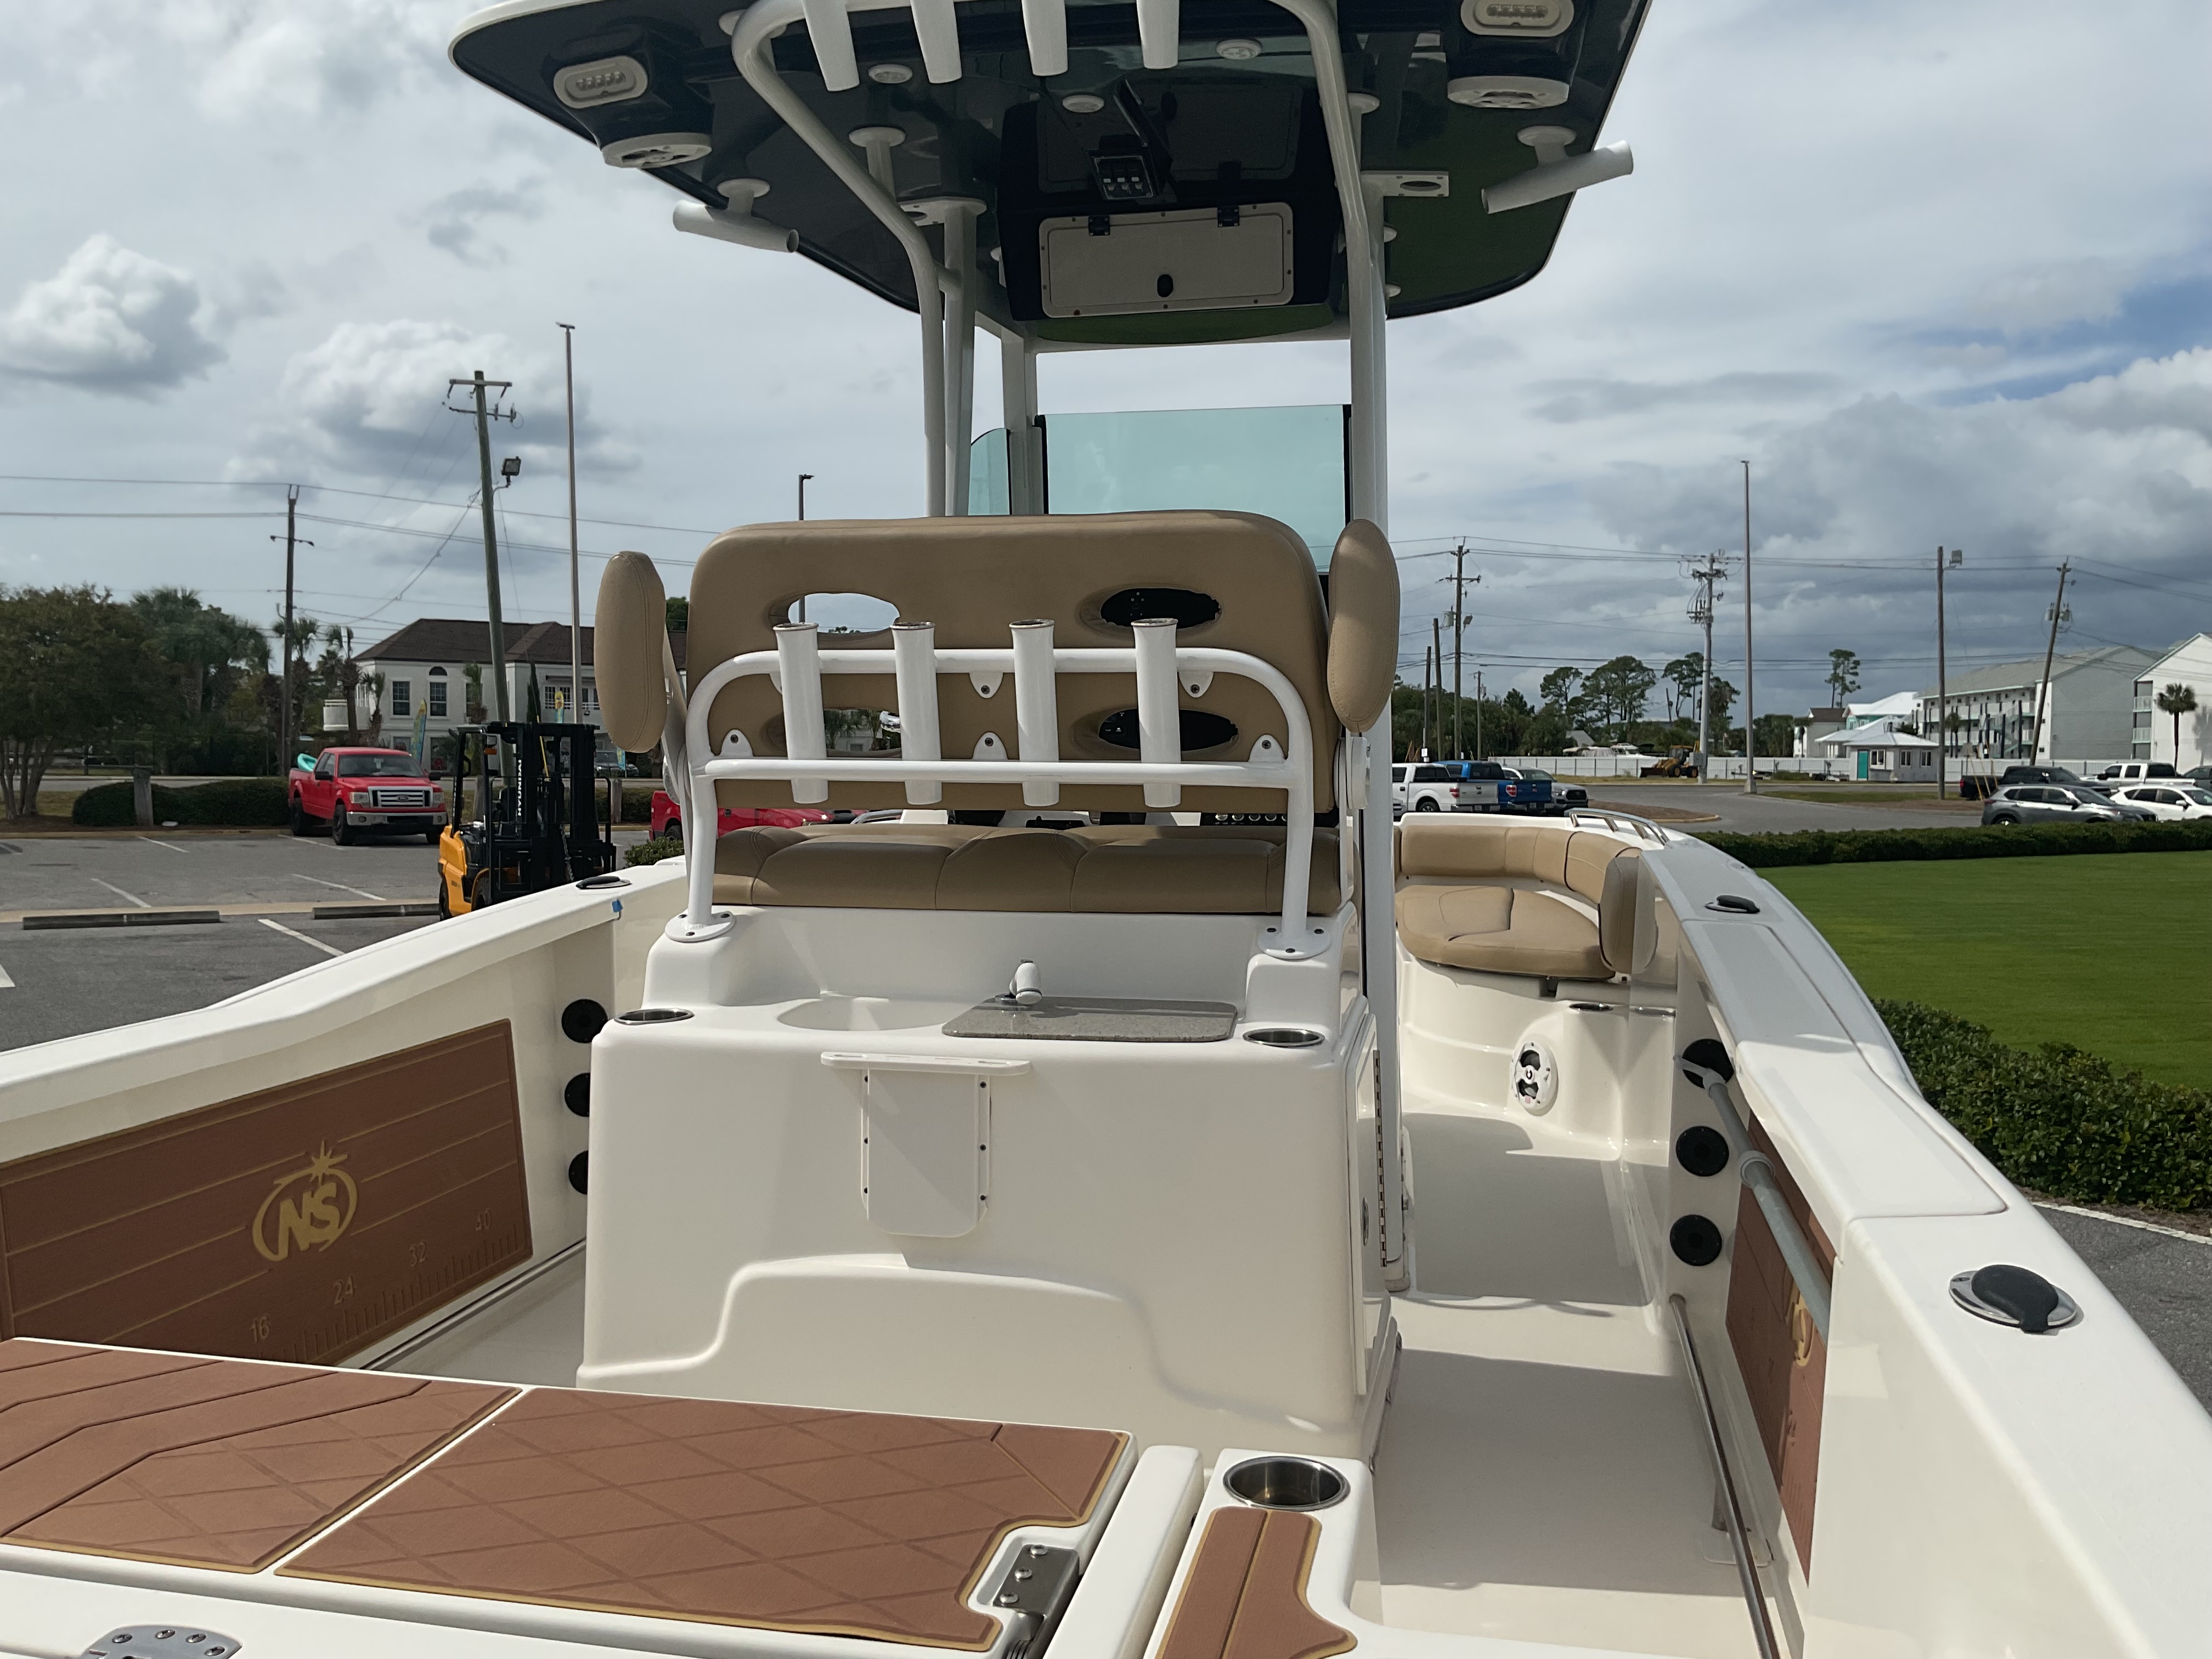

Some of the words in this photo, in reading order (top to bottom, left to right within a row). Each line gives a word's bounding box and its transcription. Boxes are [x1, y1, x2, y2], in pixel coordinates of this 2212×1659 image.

[277, 1182, 341, 1257] NS
[475, 1209, 493, 1232] 40
[409, 1240, 427, 1267] 32
[333, 1275, 355, 1305] 24
[250, 1313, 270, 1345] 16
